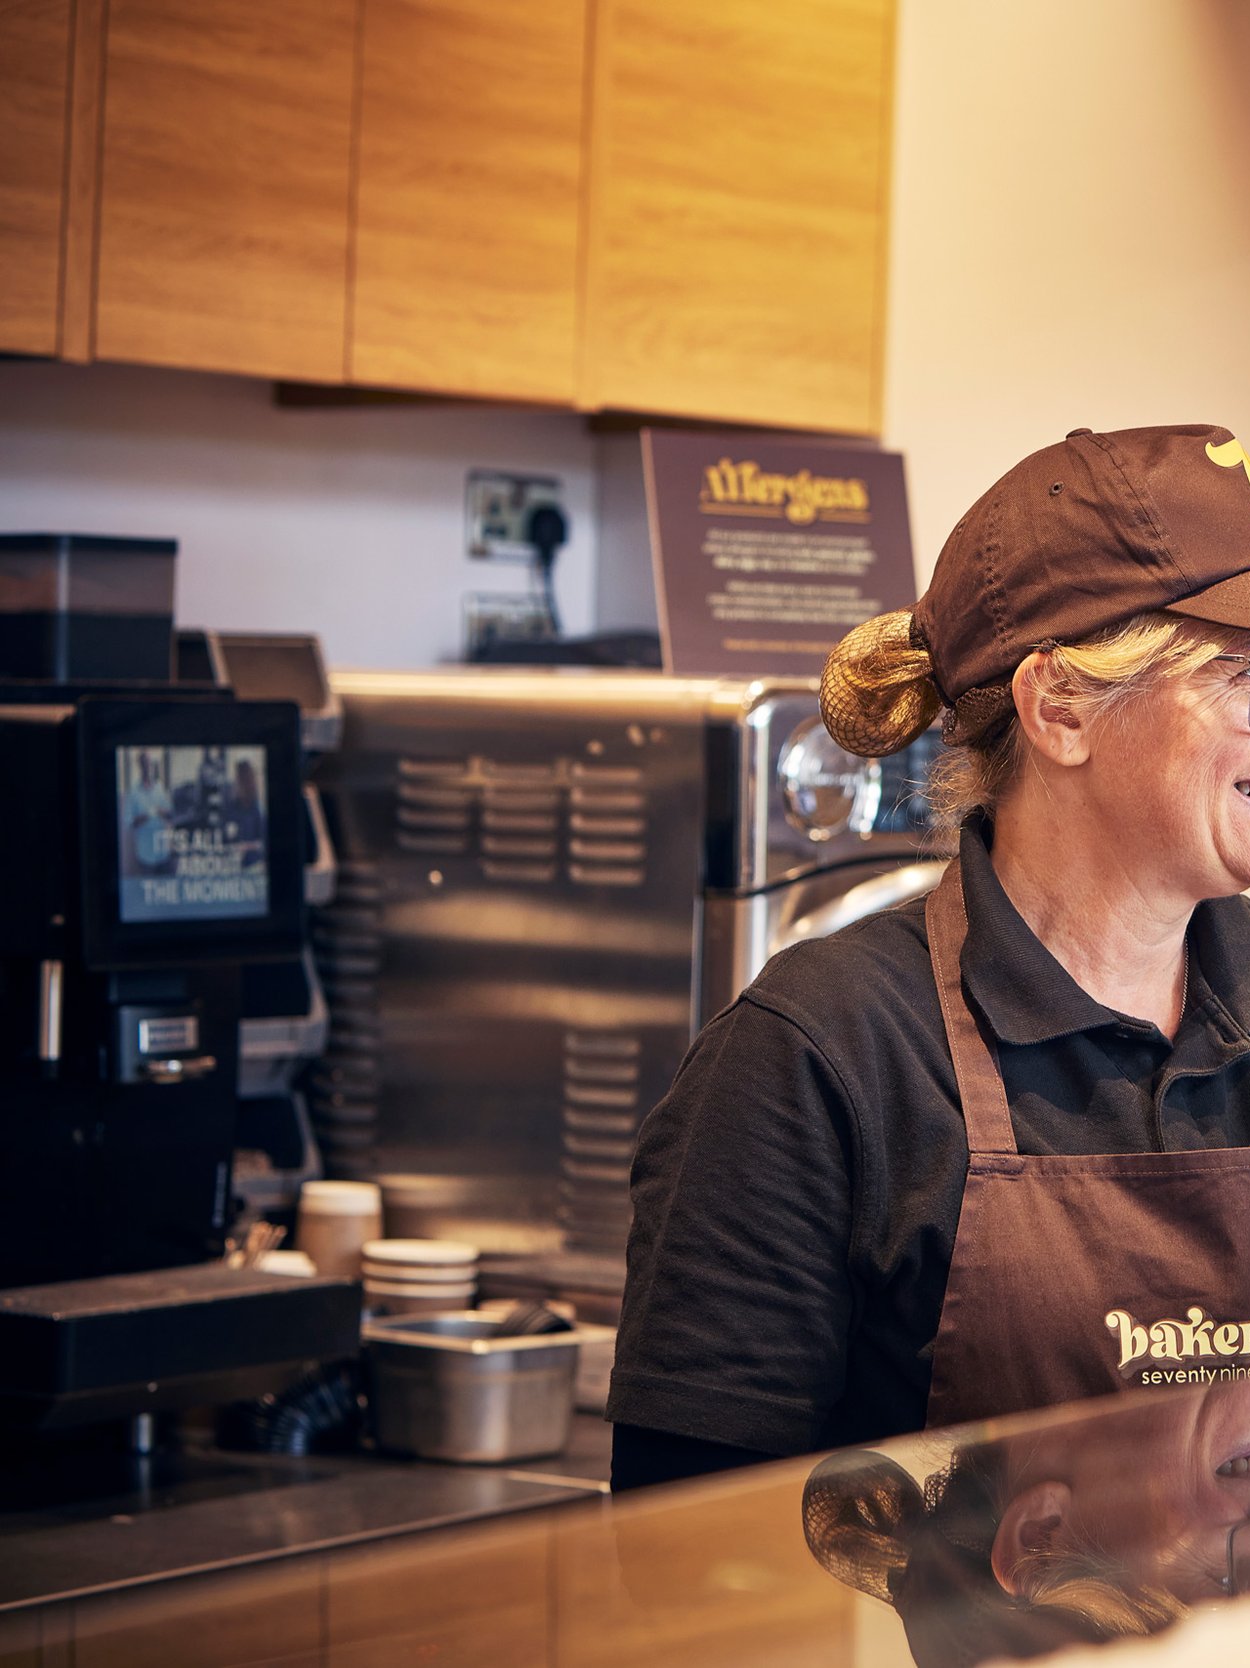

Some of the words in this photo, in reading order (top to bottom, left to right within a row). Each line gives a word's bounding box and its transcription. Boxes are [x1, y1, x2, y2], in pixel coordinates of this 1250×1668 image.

[191, 828, 225, 853] ALL
[141, 879, 181, 905] THE
[1141, 1366, 1218, 1386] seventy
